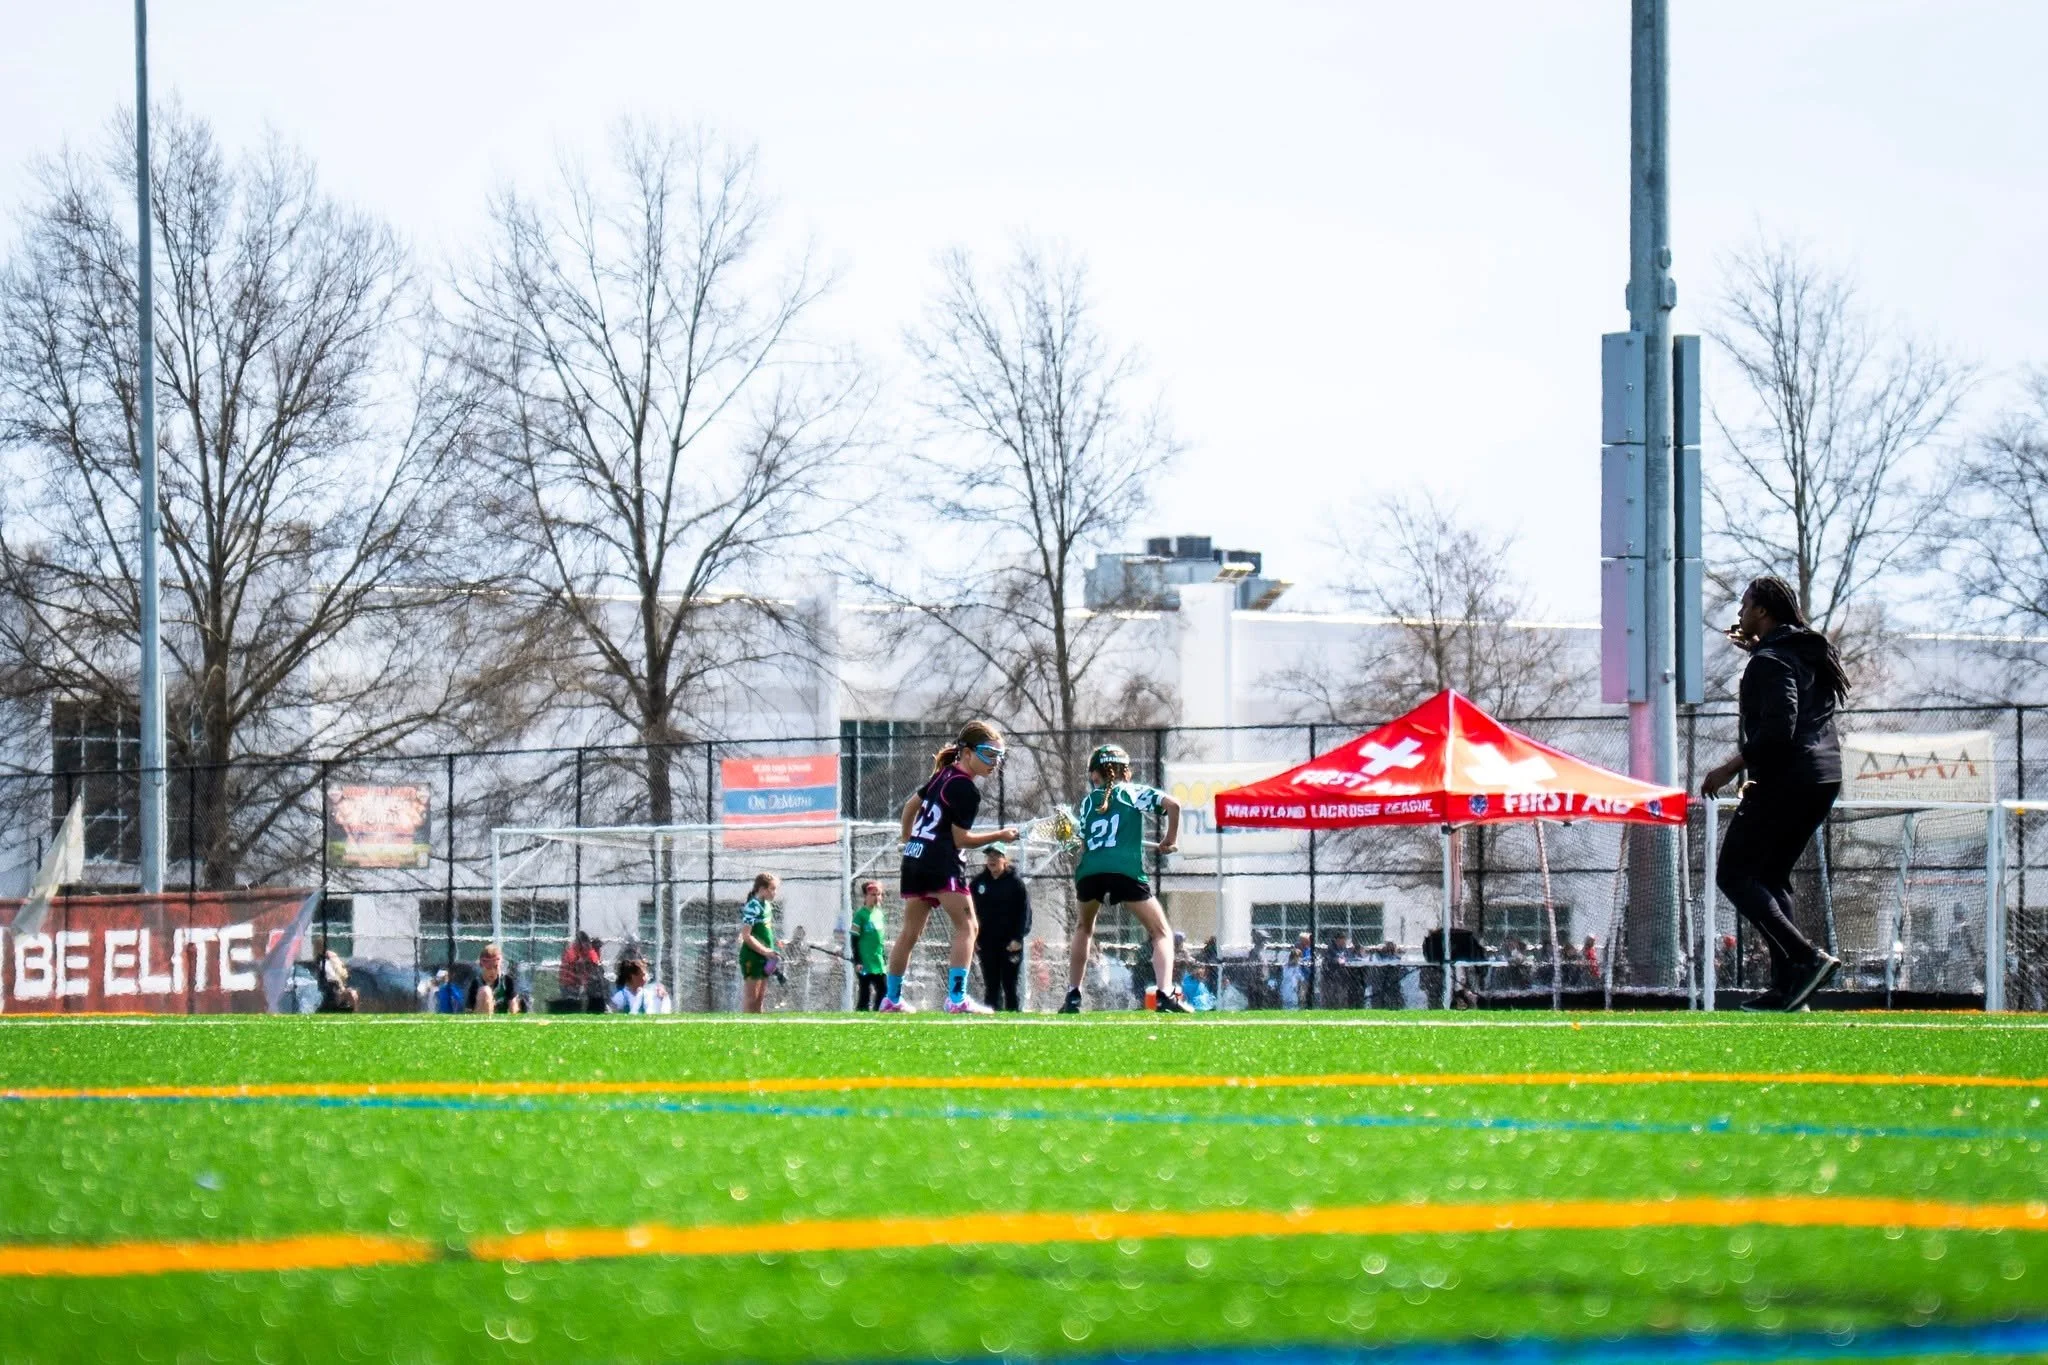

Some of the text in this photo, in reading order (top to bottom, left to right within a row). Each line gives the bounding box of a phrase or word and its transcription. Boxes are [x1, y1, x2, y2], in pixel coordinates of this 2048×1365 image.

[1224, 799, 1433, 819] MARYLAND LACROSSE LEAGUE
[1503, 791, 1635, 815] FIRST AID
[1087, 813, 1120, 851] 21
[13, 924, 257, 1000] BE ELITE
